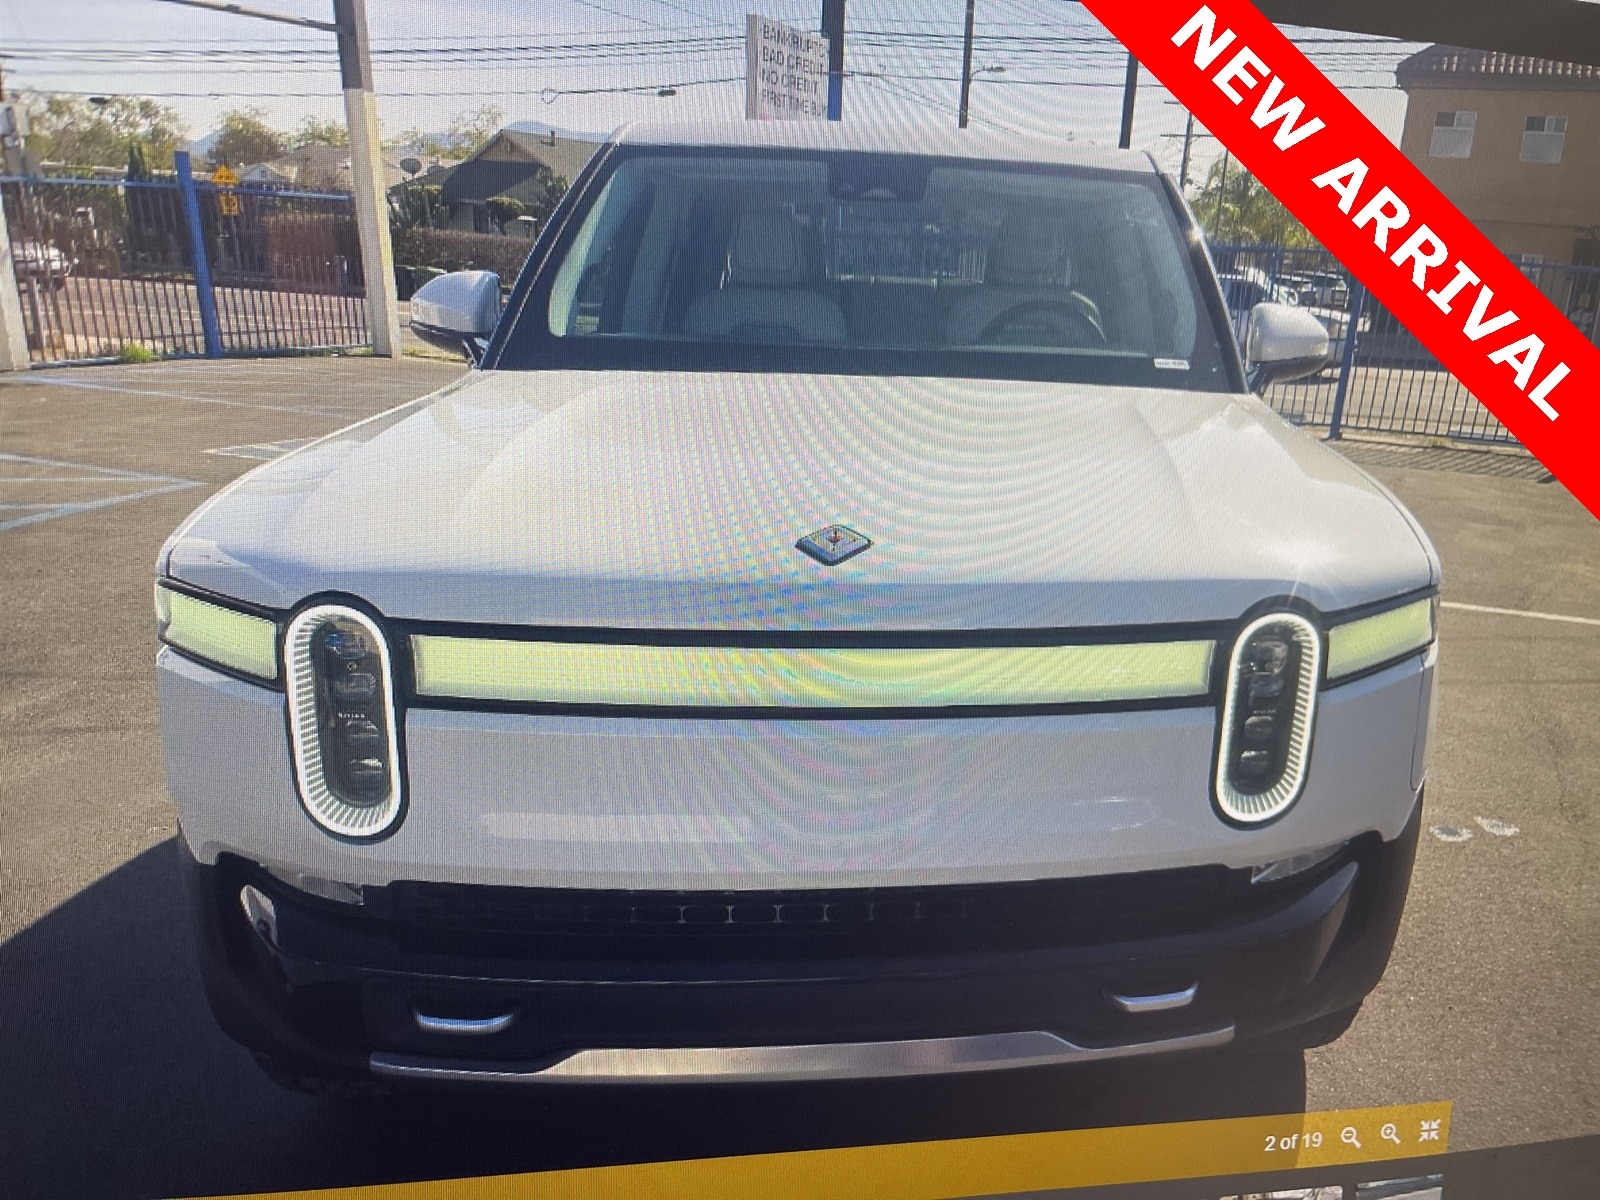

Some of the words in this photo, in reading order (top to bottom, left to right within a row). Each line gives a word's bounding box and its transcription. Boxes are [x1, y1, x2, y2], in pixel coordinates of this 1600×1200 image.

[762, 46, 784, 65] BAD
[787, 54, 824, 78] CREDIT
[761, 69, 779, 85] NO
[781, 74, 819, 95] CREDIT
[1264, 1135, 1276, 1151] 2
[1280, 1133, 1298, 1150] of
[1303, 1132, 1322, 1148] 19
